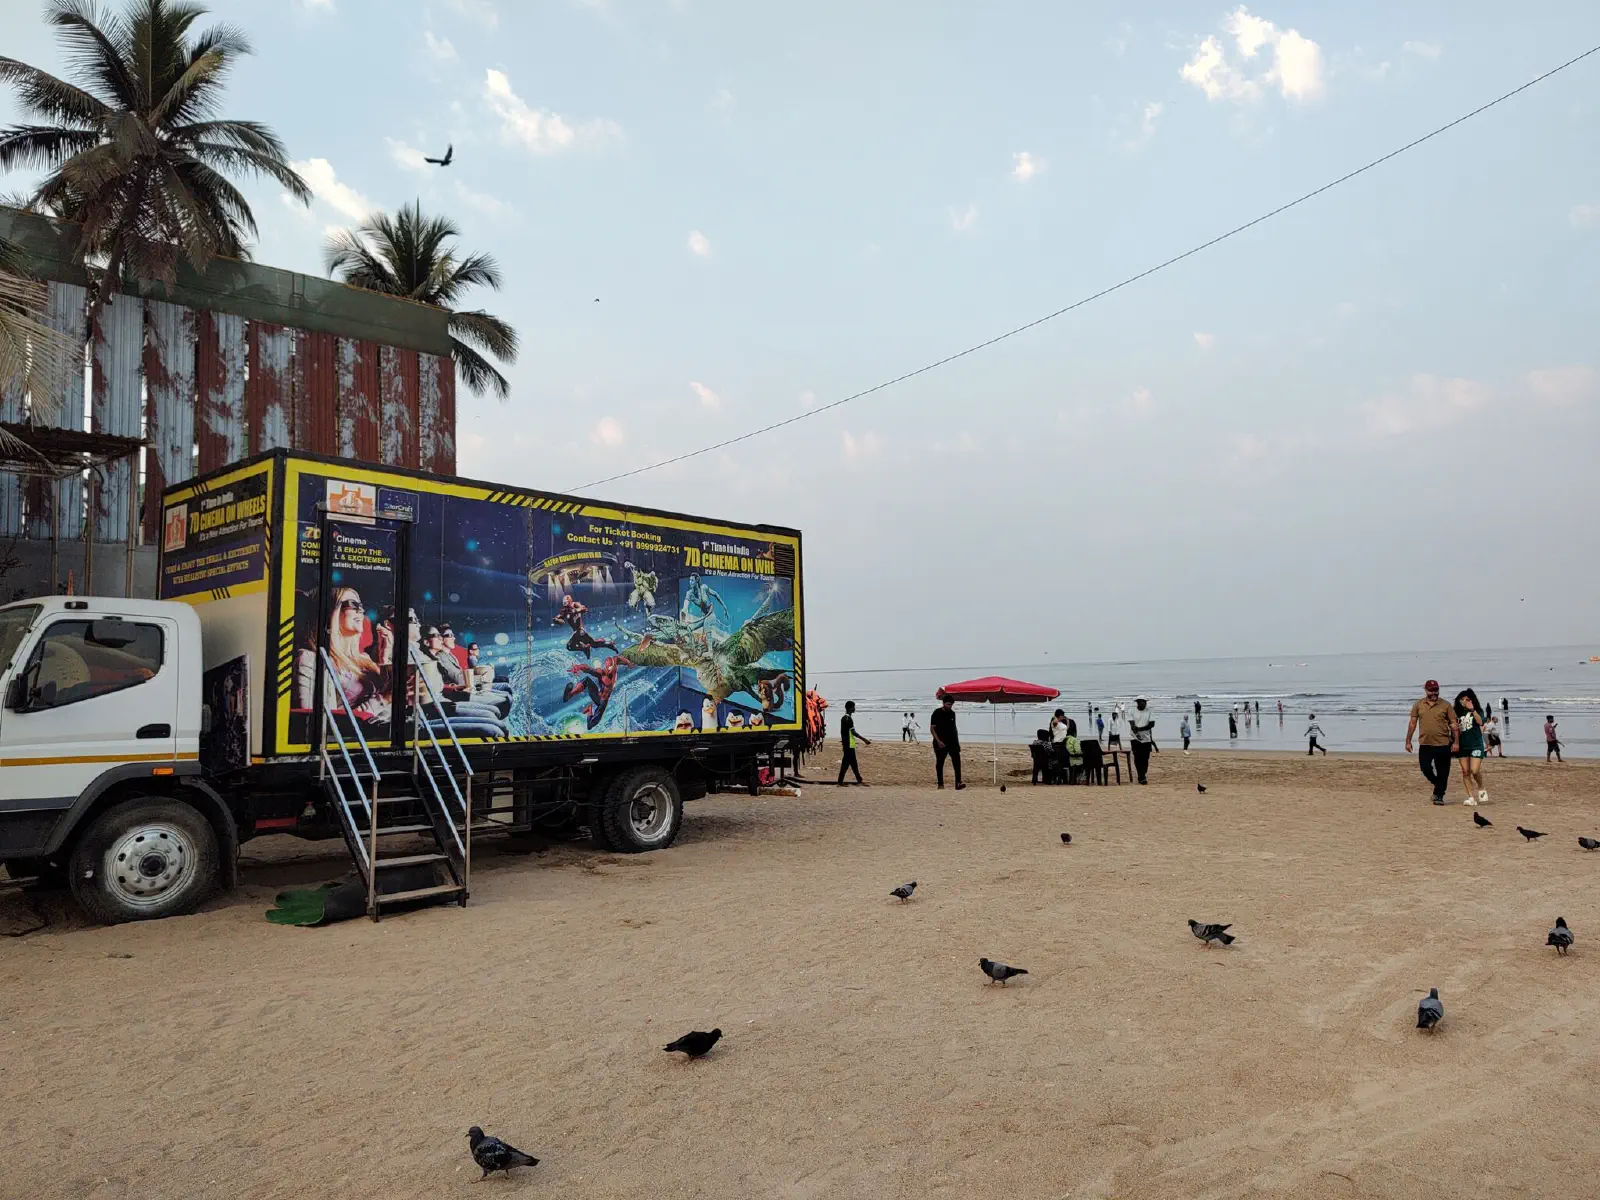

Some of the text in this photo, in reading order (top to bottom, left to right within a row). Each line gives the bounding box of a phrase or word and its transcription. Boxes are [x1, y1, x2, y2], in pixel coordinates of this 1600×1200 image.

[189, 494, 266, 534] 7D CINEMA ON WHEELS
[239, 520, 248, 530] For
[589, 524, 661, 543] For Ticket Booking
[336, 535, 367, 545] Cinema
[567, 533, 601, 544] Contact
[602, 537, 613, 546] Us
[619, 540, 634, 549] +91
[344, 546, 367, 555] ENJOY
[369, 548, 382, 556] THE
[710, 542, 726, 553] Time
[726, 545, 733, 553] in
[733, 545, 750, 556] India
[347, 554, 391, 565] EXCITEMENT
[683, 546, 775, 575] 7D CINEMA ON WHE
[353, 563, 373, 571] Special
